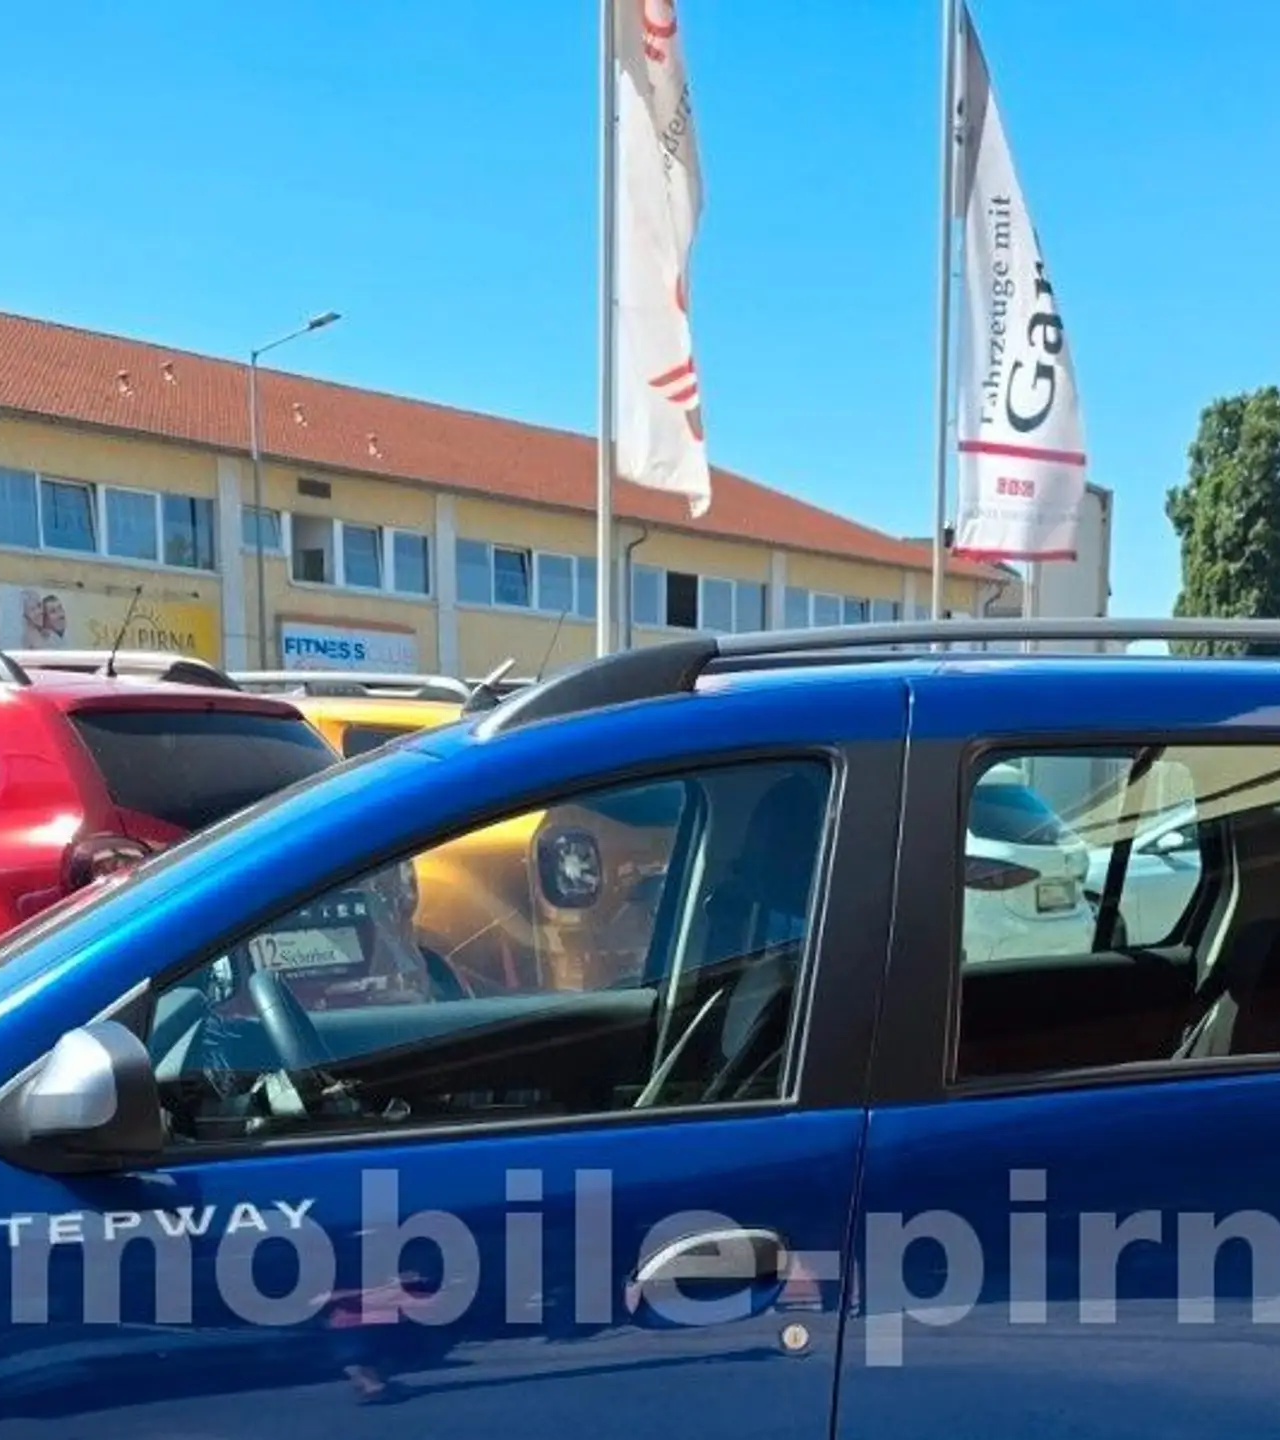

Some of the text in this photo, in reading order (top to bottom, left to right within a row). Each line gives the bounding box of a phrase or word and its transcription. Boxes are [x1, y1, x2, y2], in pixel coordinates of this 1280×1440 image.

[989, 194, 1012, 250] mit
[138, 627, 196, 650] PIRNA
[285, 636, 366, 662] FITNESS
